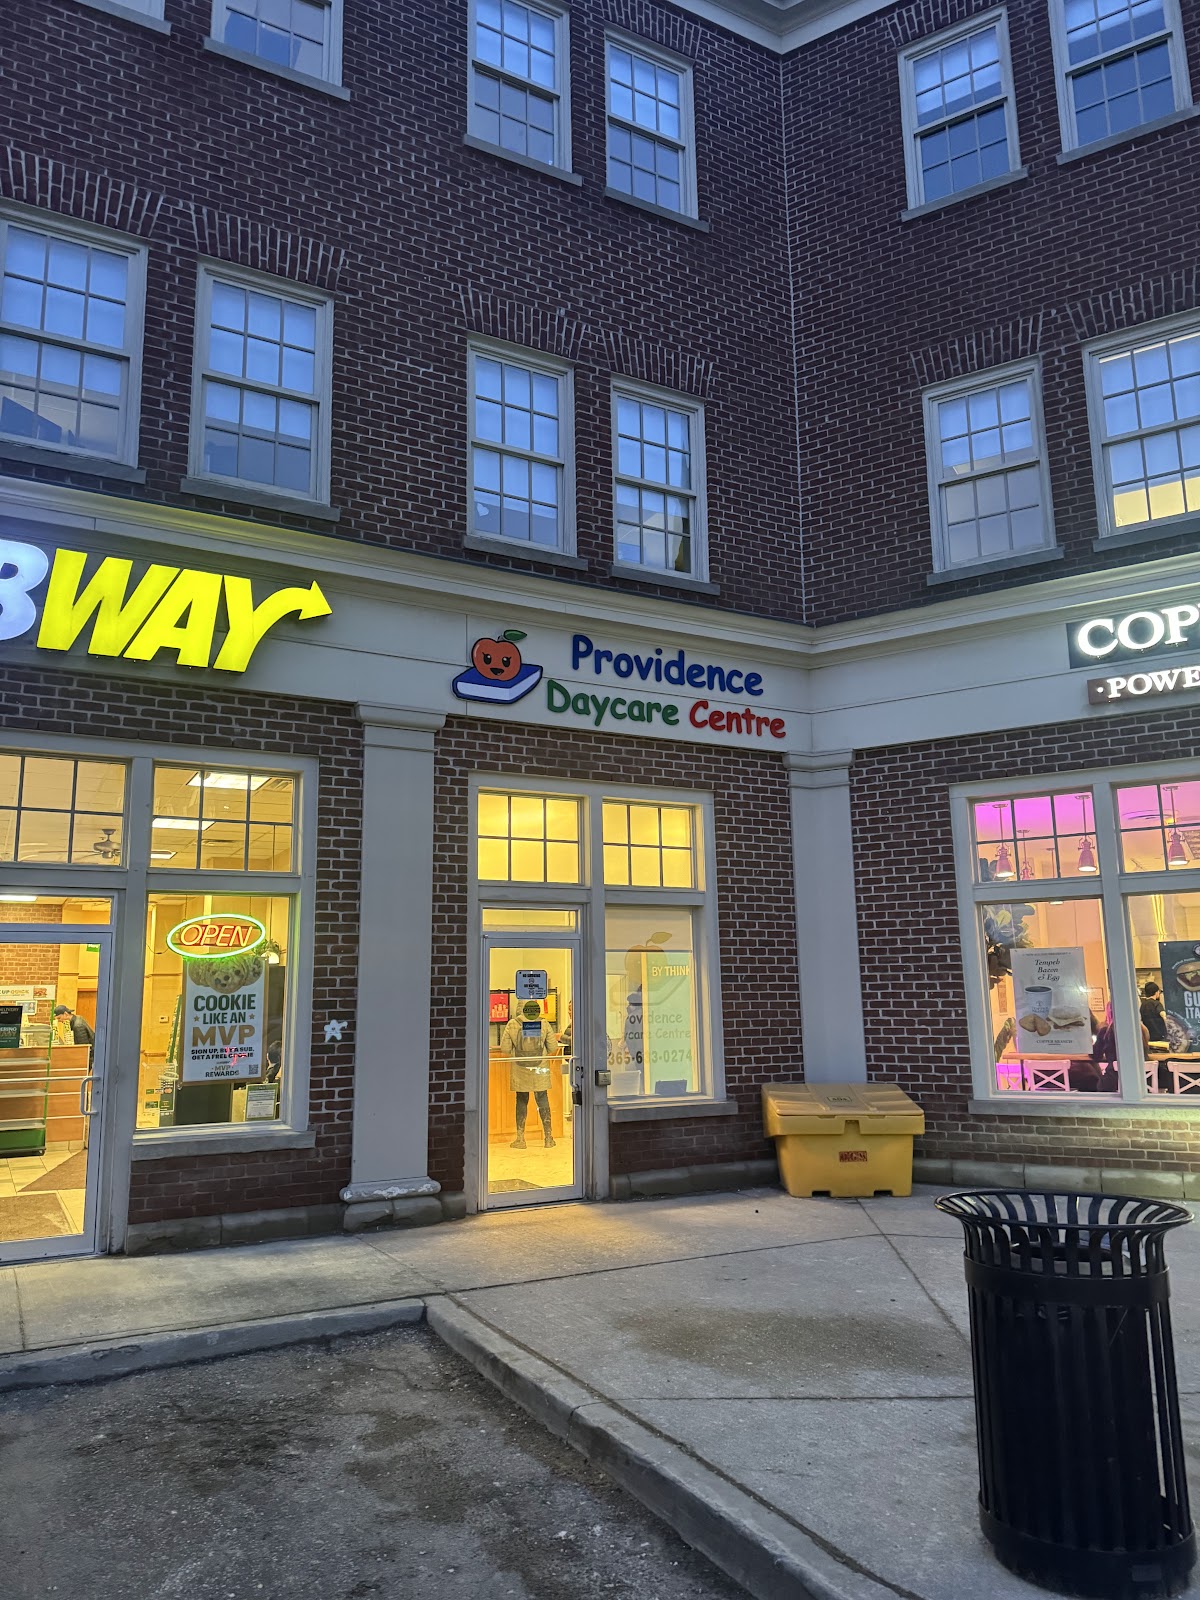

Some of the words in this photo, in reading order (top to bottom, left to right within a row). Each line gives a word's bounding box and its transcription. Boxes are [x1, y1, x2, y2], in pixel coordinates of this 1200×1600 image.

[1077, 604, 1200, 656] COP
[571, 633, 764, 697] Providence
[547, 678, 680, 727] Daycare
[688, 700, 787, 739] Centre
[180, 924, 253, 947] OPEN
[652, 966, 663, 976] BY
[193, 993, 256, 1012] COOKIE
[202, 1012, 228, 1025] LIKE
[229, 1011, 246, 1024] AN
[192, 1024, 256, 1047] MVP
[205, 1070, 240, 1078] REWARDS
